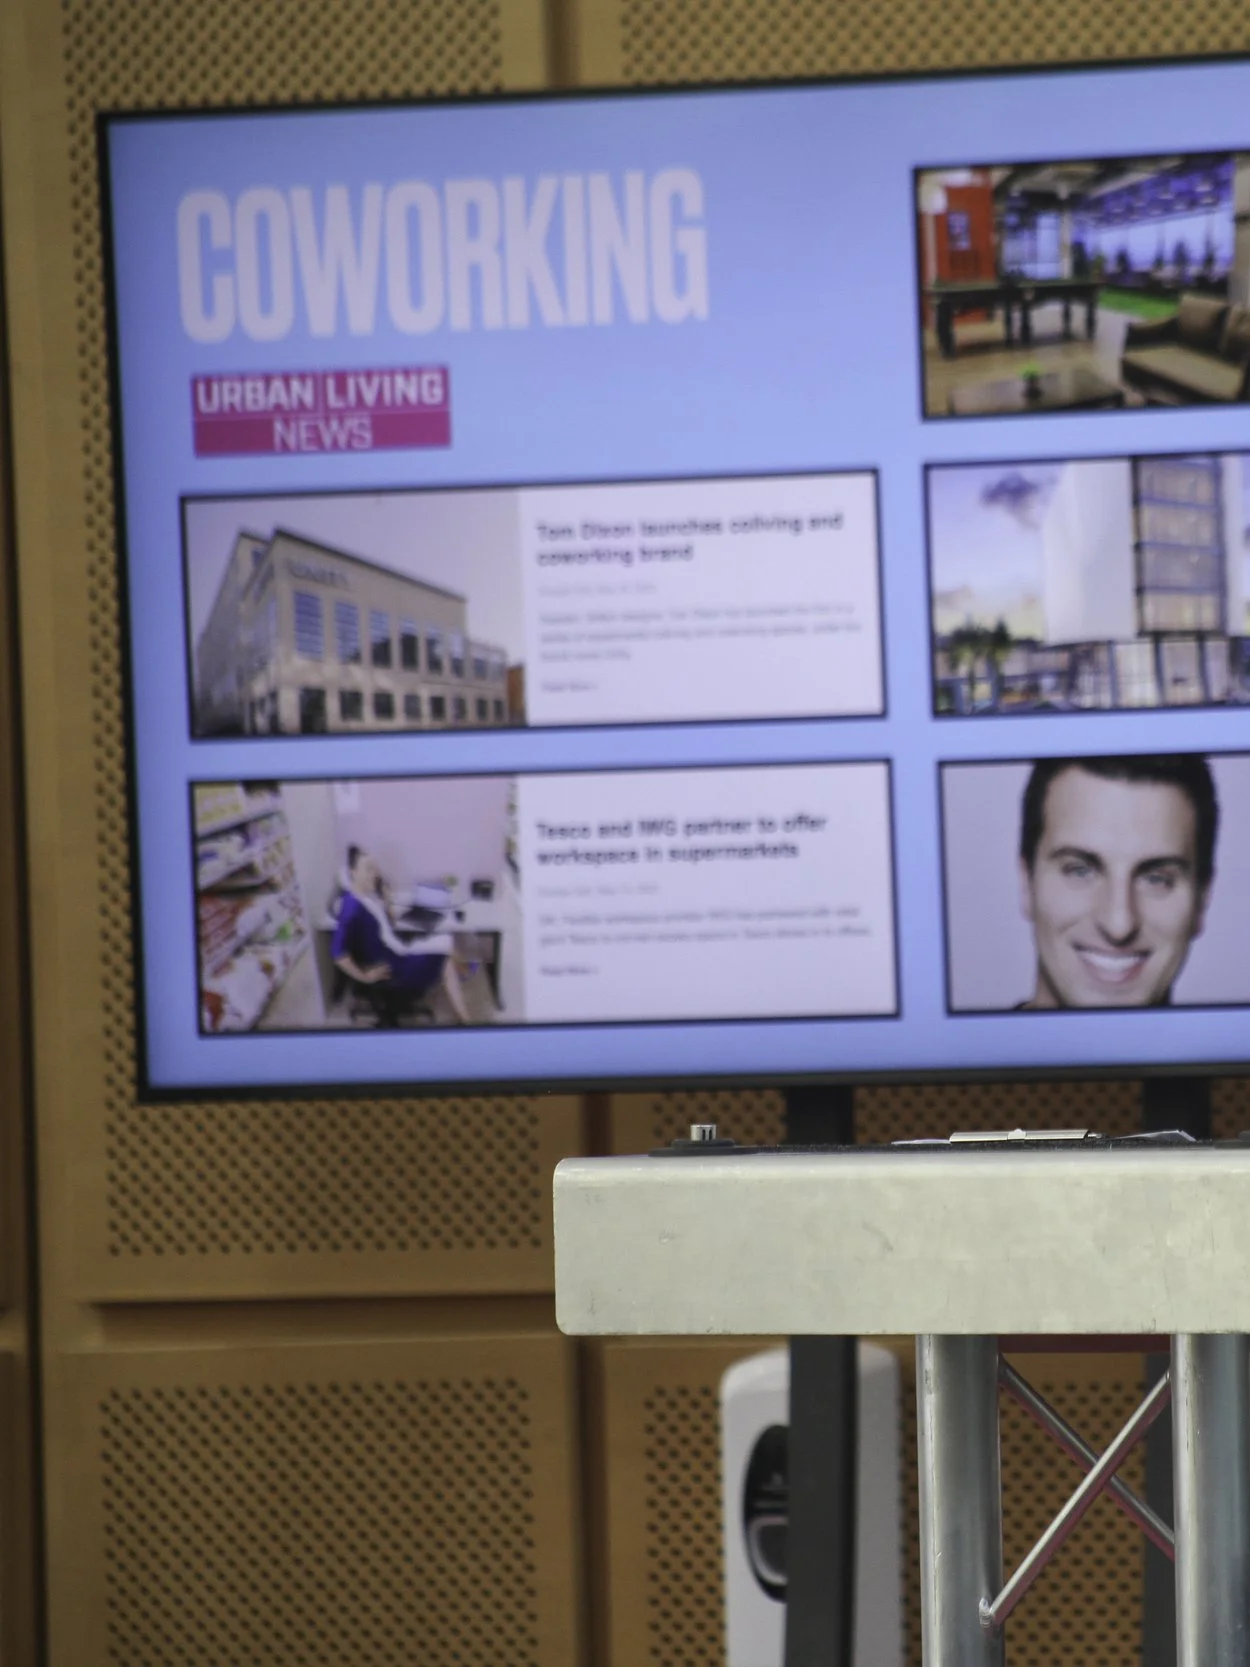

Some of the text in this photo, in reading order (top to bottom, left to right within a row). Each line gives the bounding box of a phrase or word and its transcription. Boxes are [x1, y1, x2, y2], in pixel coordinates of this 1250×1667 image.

[176, 166, 709, 344] COWORKING
[196, 372, 444, 414] URBAN LIVING
[274, 415, 373, 452] NEWS
[537, 523, 574, 541] Tom
[639, 516, 722, 537] launches
[808, 513, 843, 531] and
[537, 544, 693, 567] coworking brand
[536, 821, 591, 840] Tesco
[598, 819, 632, 838] and
[683, 817, 751, 838] partner
[758, 816, 777, 834] to
[783, 813, 826, 833] offer
[536, 842, 799, 868] workspace in supermarkets
